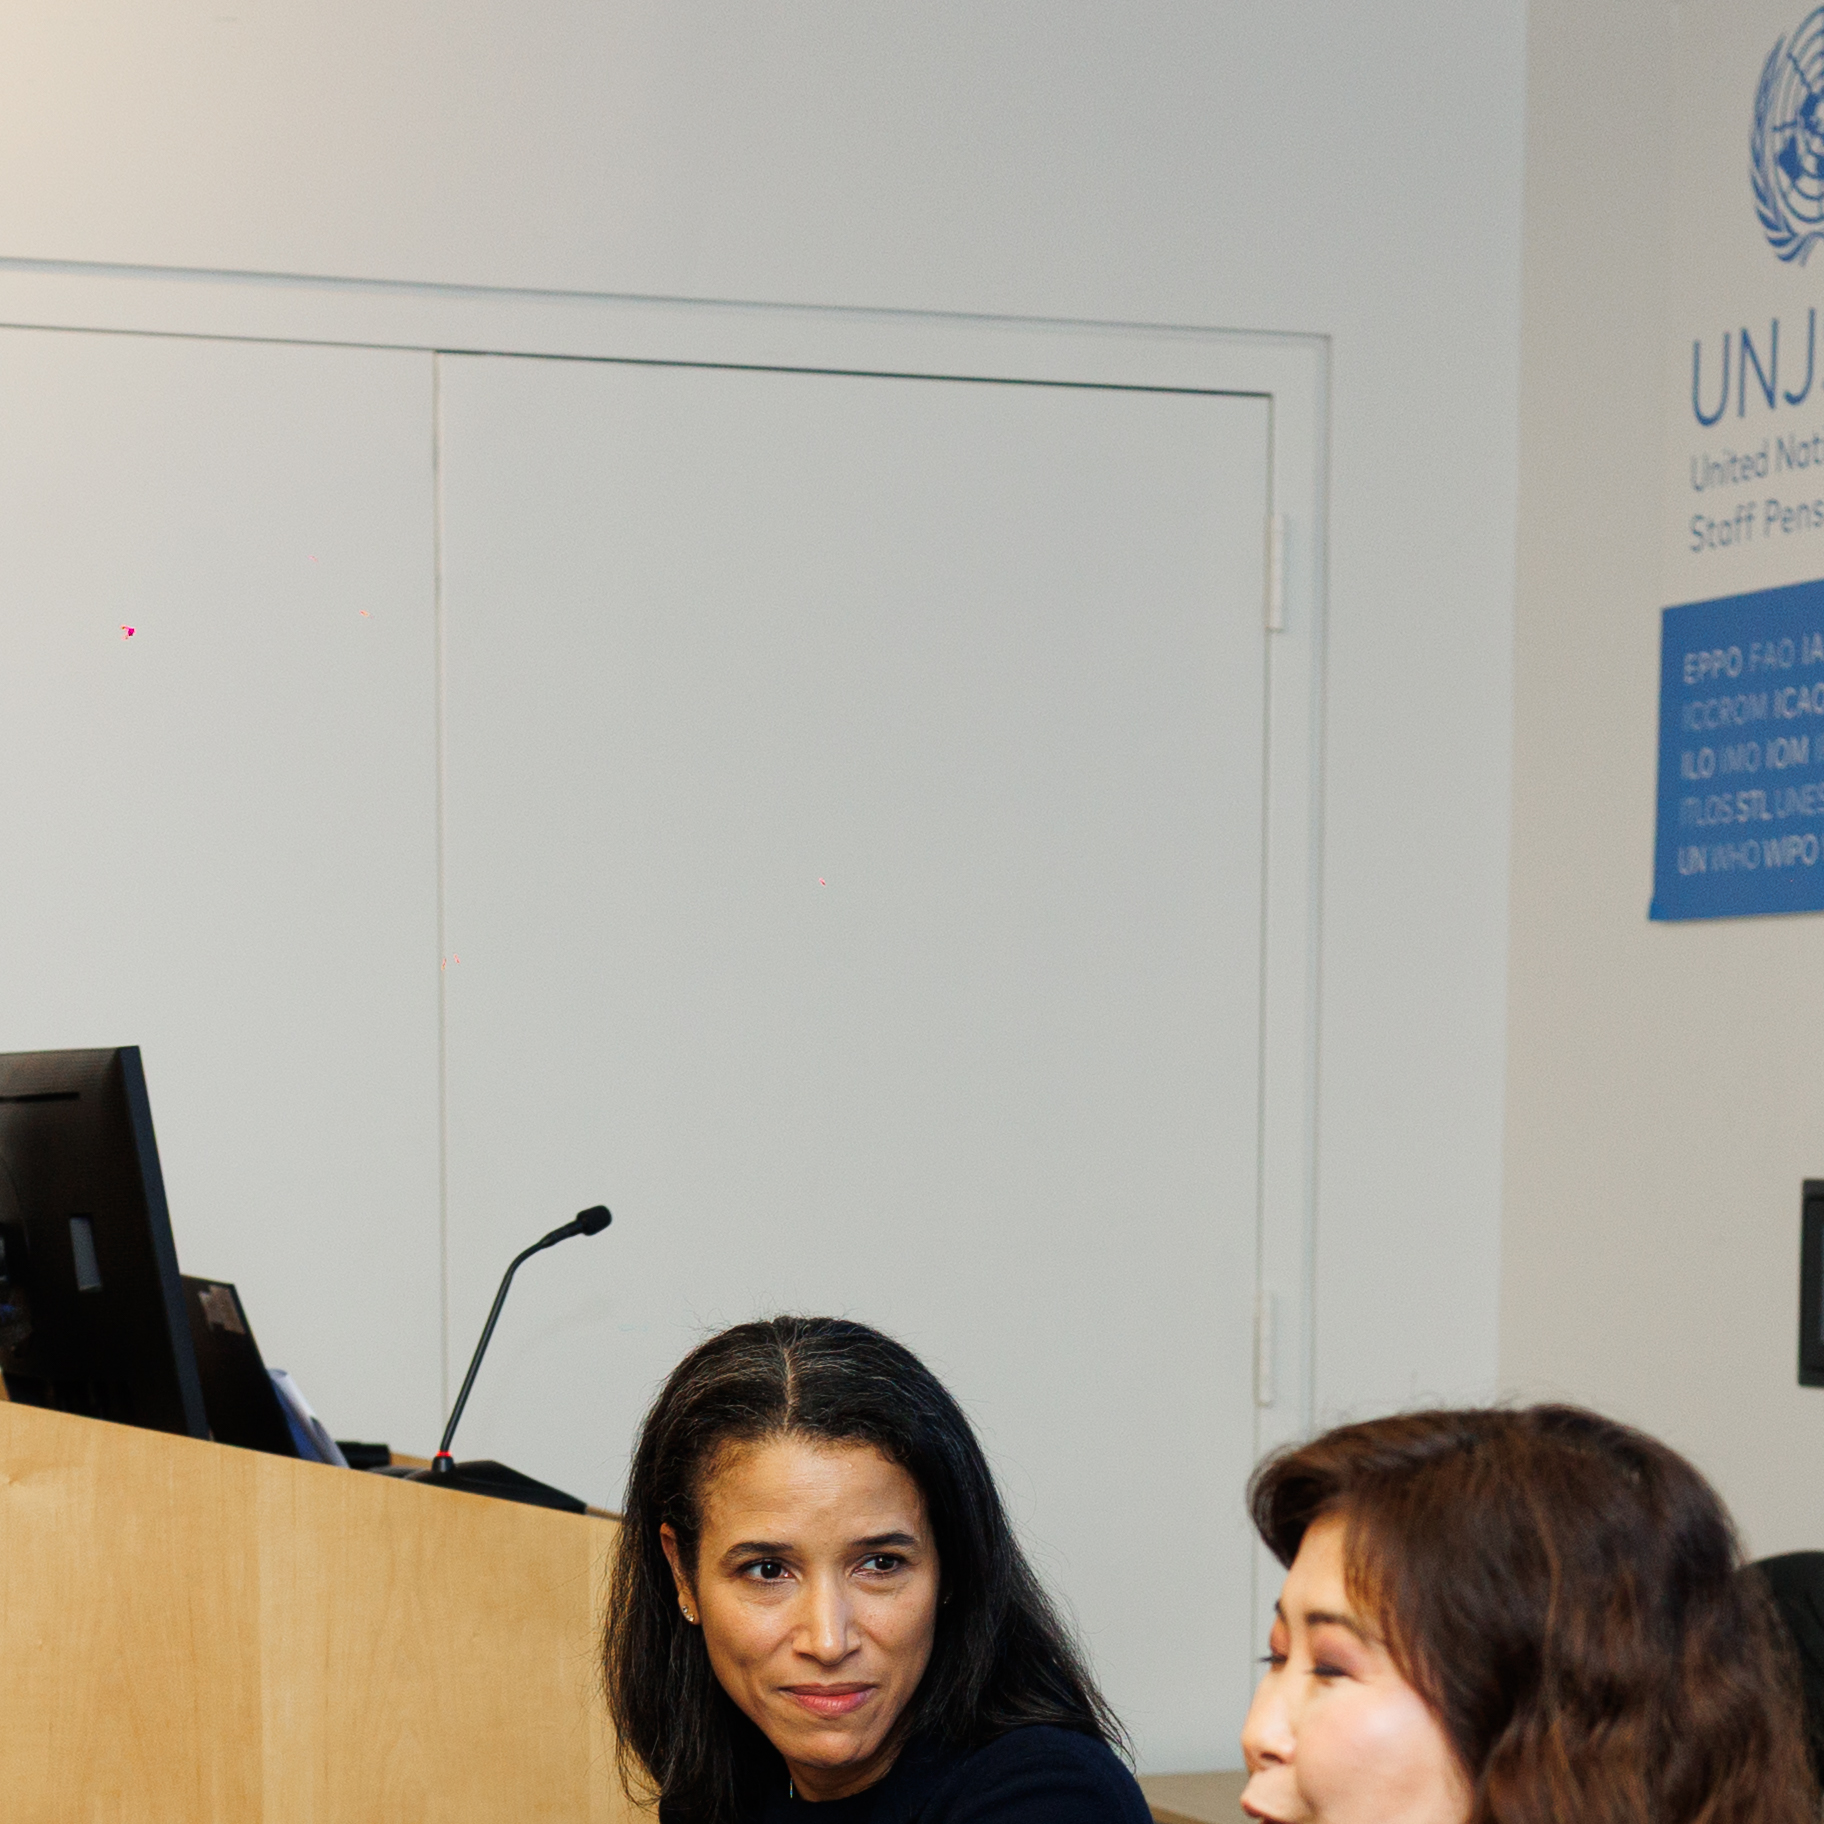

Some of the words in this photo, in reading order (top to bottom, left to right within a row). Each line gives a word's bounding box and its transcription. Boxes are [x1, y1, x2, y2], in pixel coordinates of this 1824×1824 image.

[1690, 437, 1769, 492] United
[1690, 500, 1756, 553] Staff
[1683, 645, 1743, 685] EPPO
[1748, 637, 1794, 672] FAO
[1680, 746, 1716, 780] ILO
[1766, 735, 1809, 770] IOM
[1735, 789, 1774, 823] STL
[1677, 843, 1706, 876] UN
